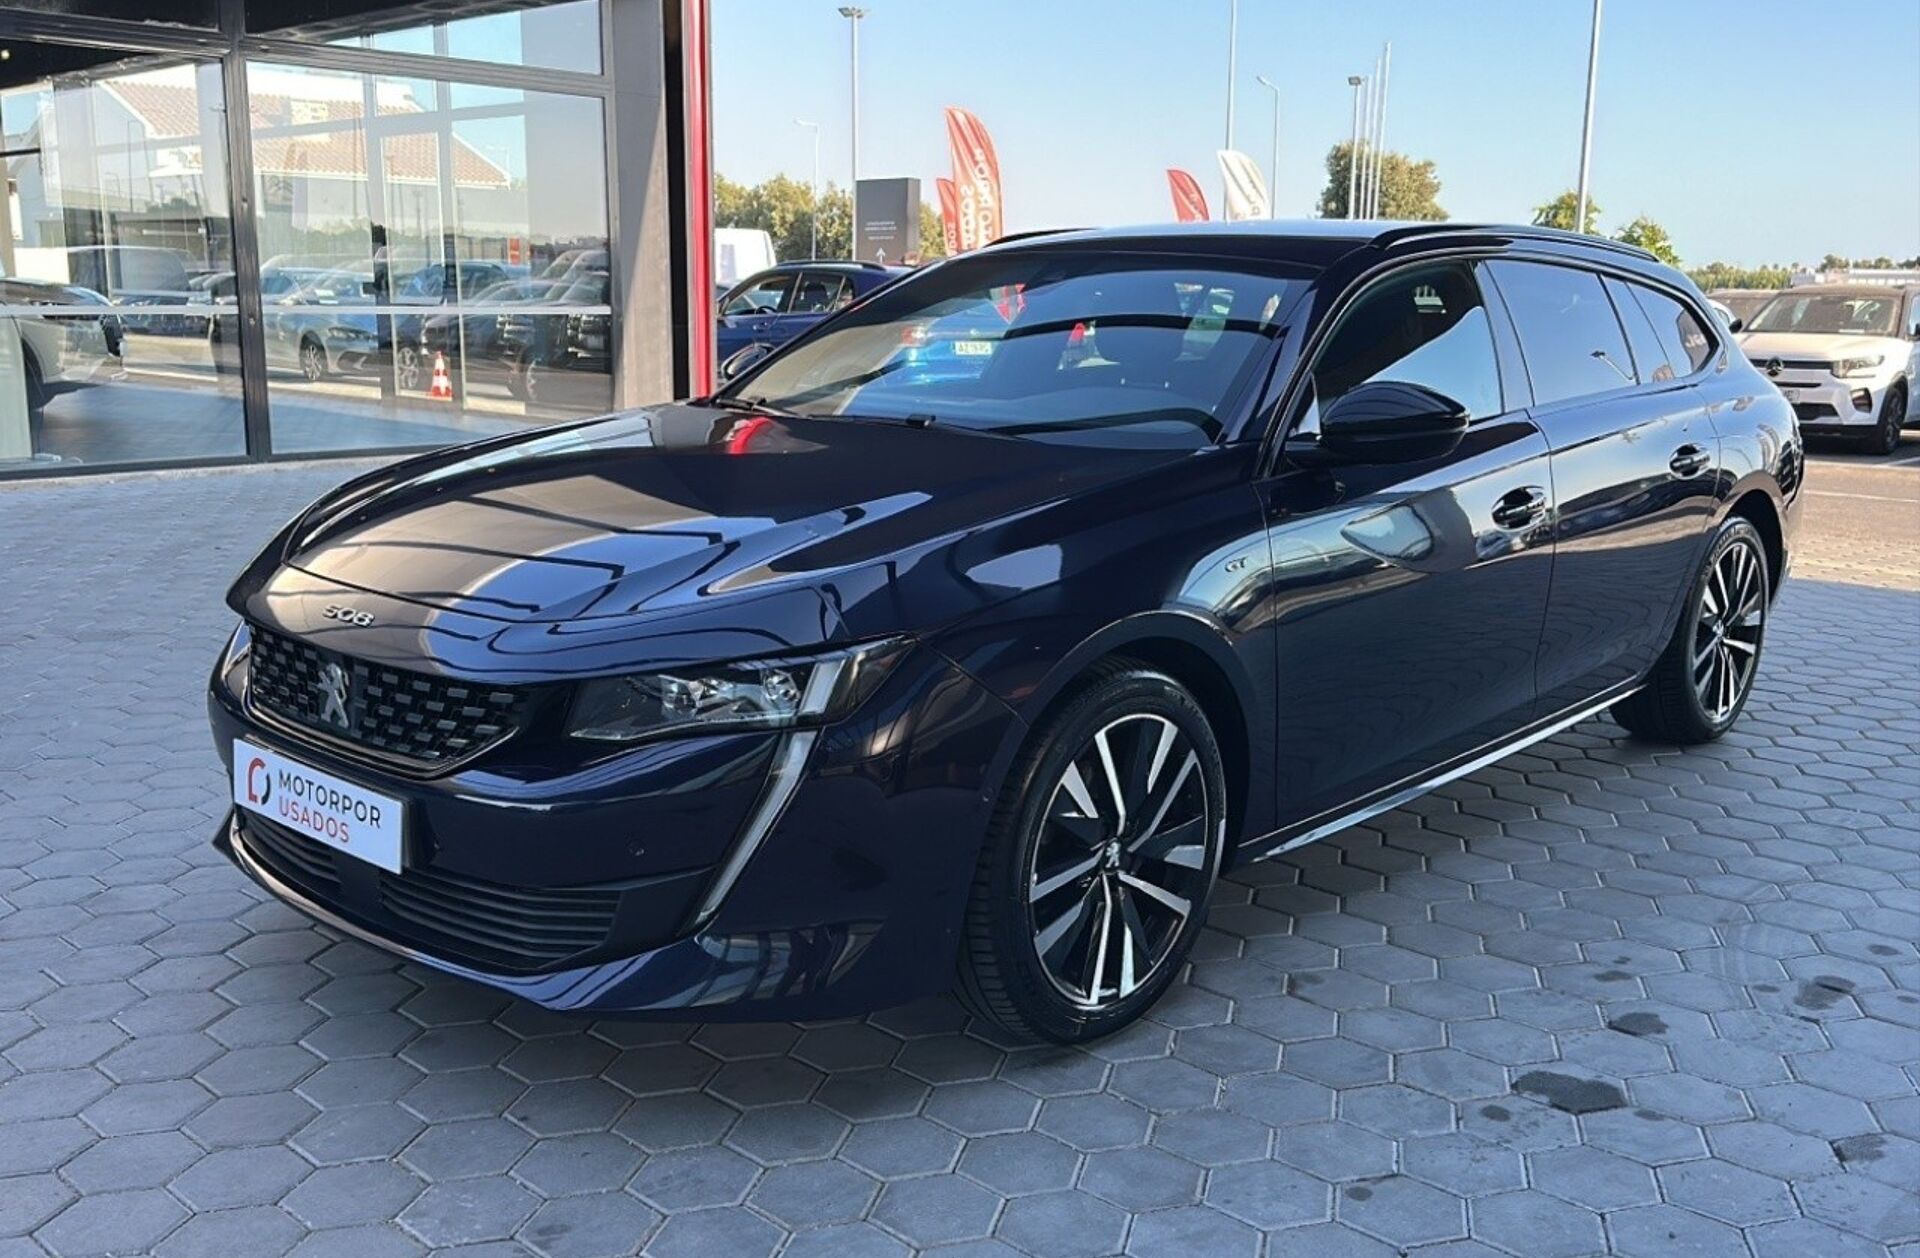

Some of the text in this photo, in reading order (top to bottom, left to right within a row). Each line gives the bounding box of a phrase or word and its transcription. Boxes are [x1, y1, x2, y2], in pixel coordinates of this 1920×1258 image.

[1224, 556, 1249, 573] GT
[321, 604, 375, 628] 508
[278, 769, 381, 829] MOTORPOR
[279, 796, 349, 843] USADOS
